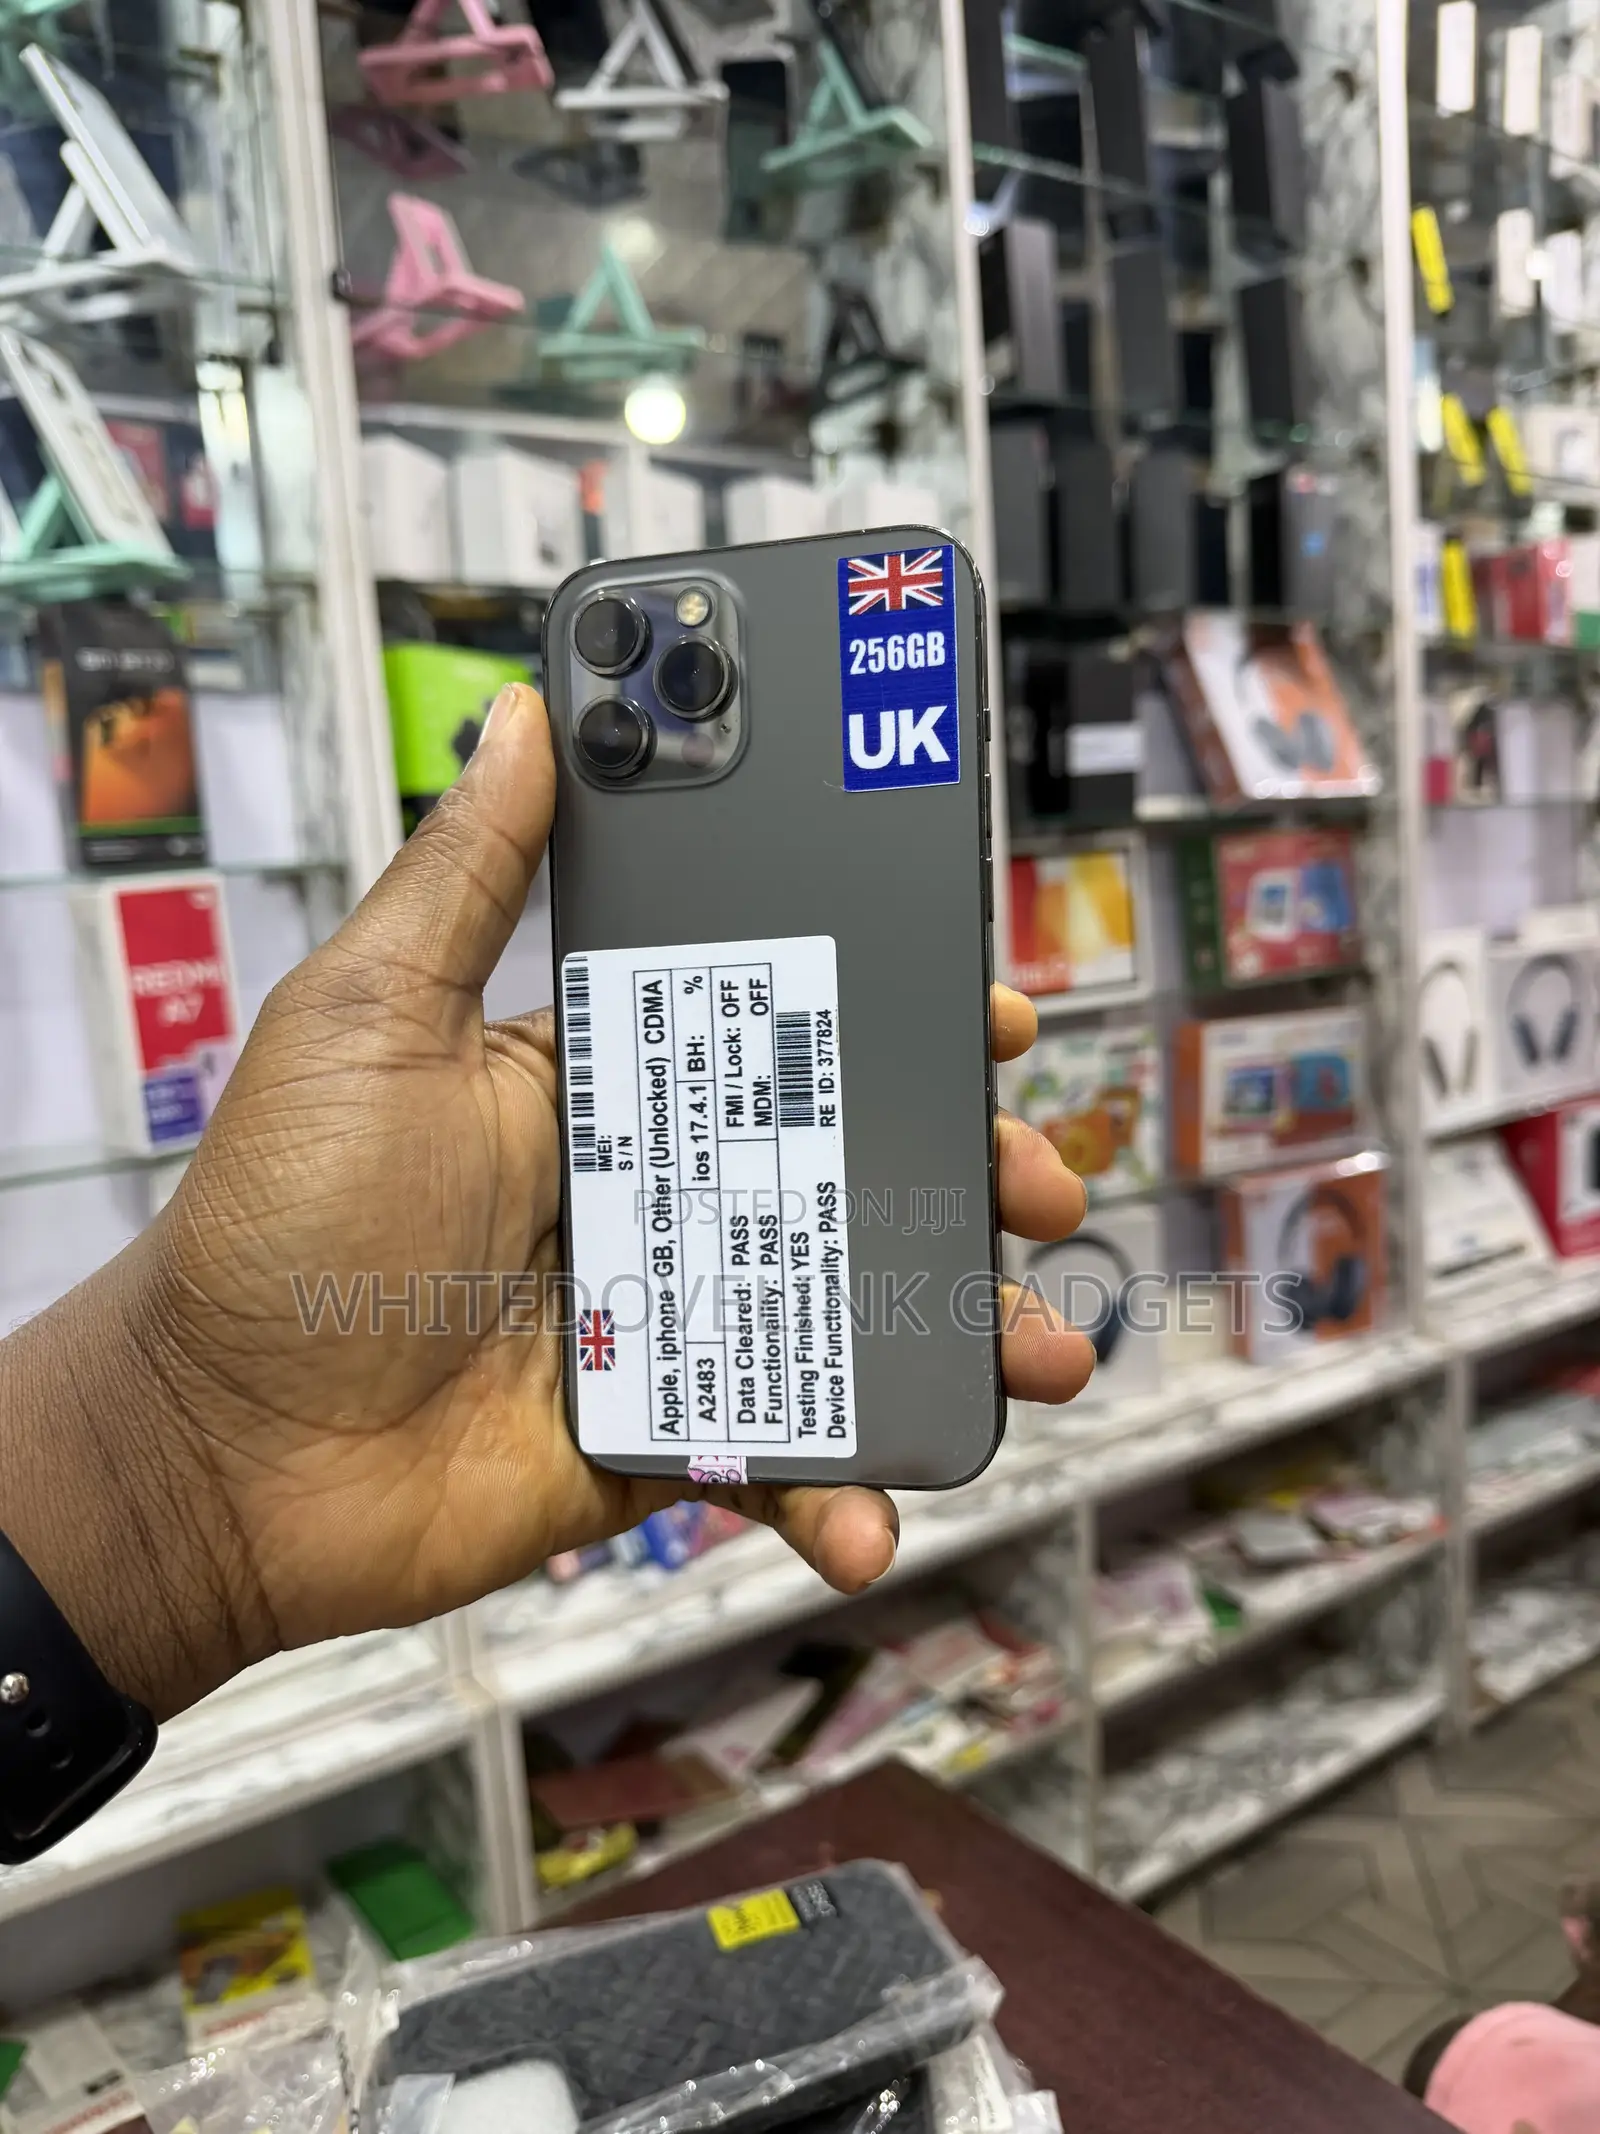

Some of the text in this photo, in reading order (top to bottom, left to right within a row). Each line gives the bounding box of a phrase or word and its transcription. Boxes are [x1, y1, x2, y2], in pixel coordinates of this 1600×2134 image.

[849, 631, 946, 675] 256GB
[848, 705, 951, 769] UK
[684, 975, 706, 1072] BH: %
[720, 980, 740, 1018] OFF
[723, 1027, 742, 1078] Lock:
[749, 978, 772, 1126] MDM: OFF
[816, 1009, 836, 1127] RE ID: 377824
[618, 1136, 633, 1146] N
[688, 1086, 710, 1181] ios 17.4.1
[726, 1095, 744, 1128] FMI
[598, 1135, 613, 1172] IMEI:
[619, 1160, 634, 1171] S
[643, 979, 684, 1435] Apple, iphone GB, Other (Unlocked) CDMA
[730, 1215, 756, 1423] Data Cleared: PASS
[758, 1215, 784, 1424] Functionality: PASS
[790, 1232, 819, 1438] Testing Finished: YES
[817, 1181, 846, 1438] Device Functionality: PASS
[697, 1358, 716, 1422] A2483
